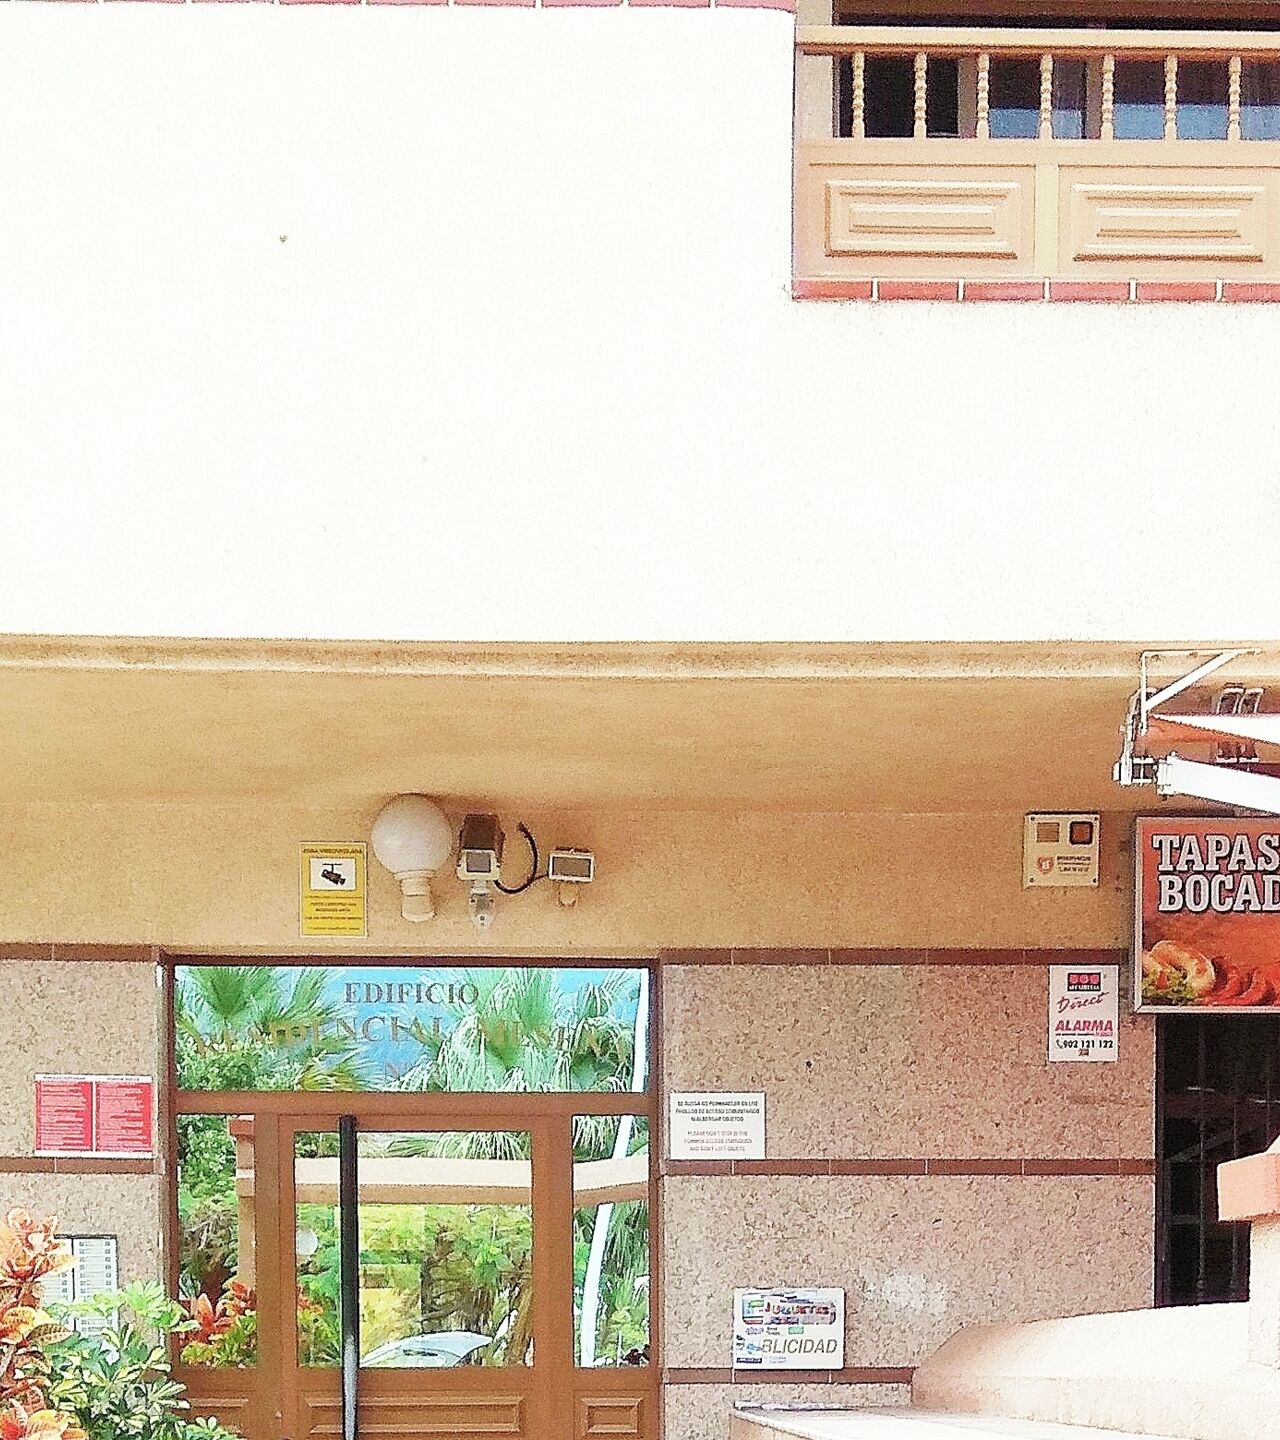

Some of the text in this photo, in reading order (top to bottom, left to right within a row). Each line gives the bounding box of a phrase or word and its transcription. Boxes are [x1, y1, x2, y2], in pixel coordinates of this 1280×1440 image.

[1152, 834, 1280, 871] TAPAS
[344, 981, 479, 1004] EDIFICIO
[1056, 991, 1110, 1013] Direct
[1055, 1020, 1113, 1031] ALARMA
[1063, 1040, 1113, 1049] 902 121 122
[762, 1339, 838, 1354] BLICIDAD
